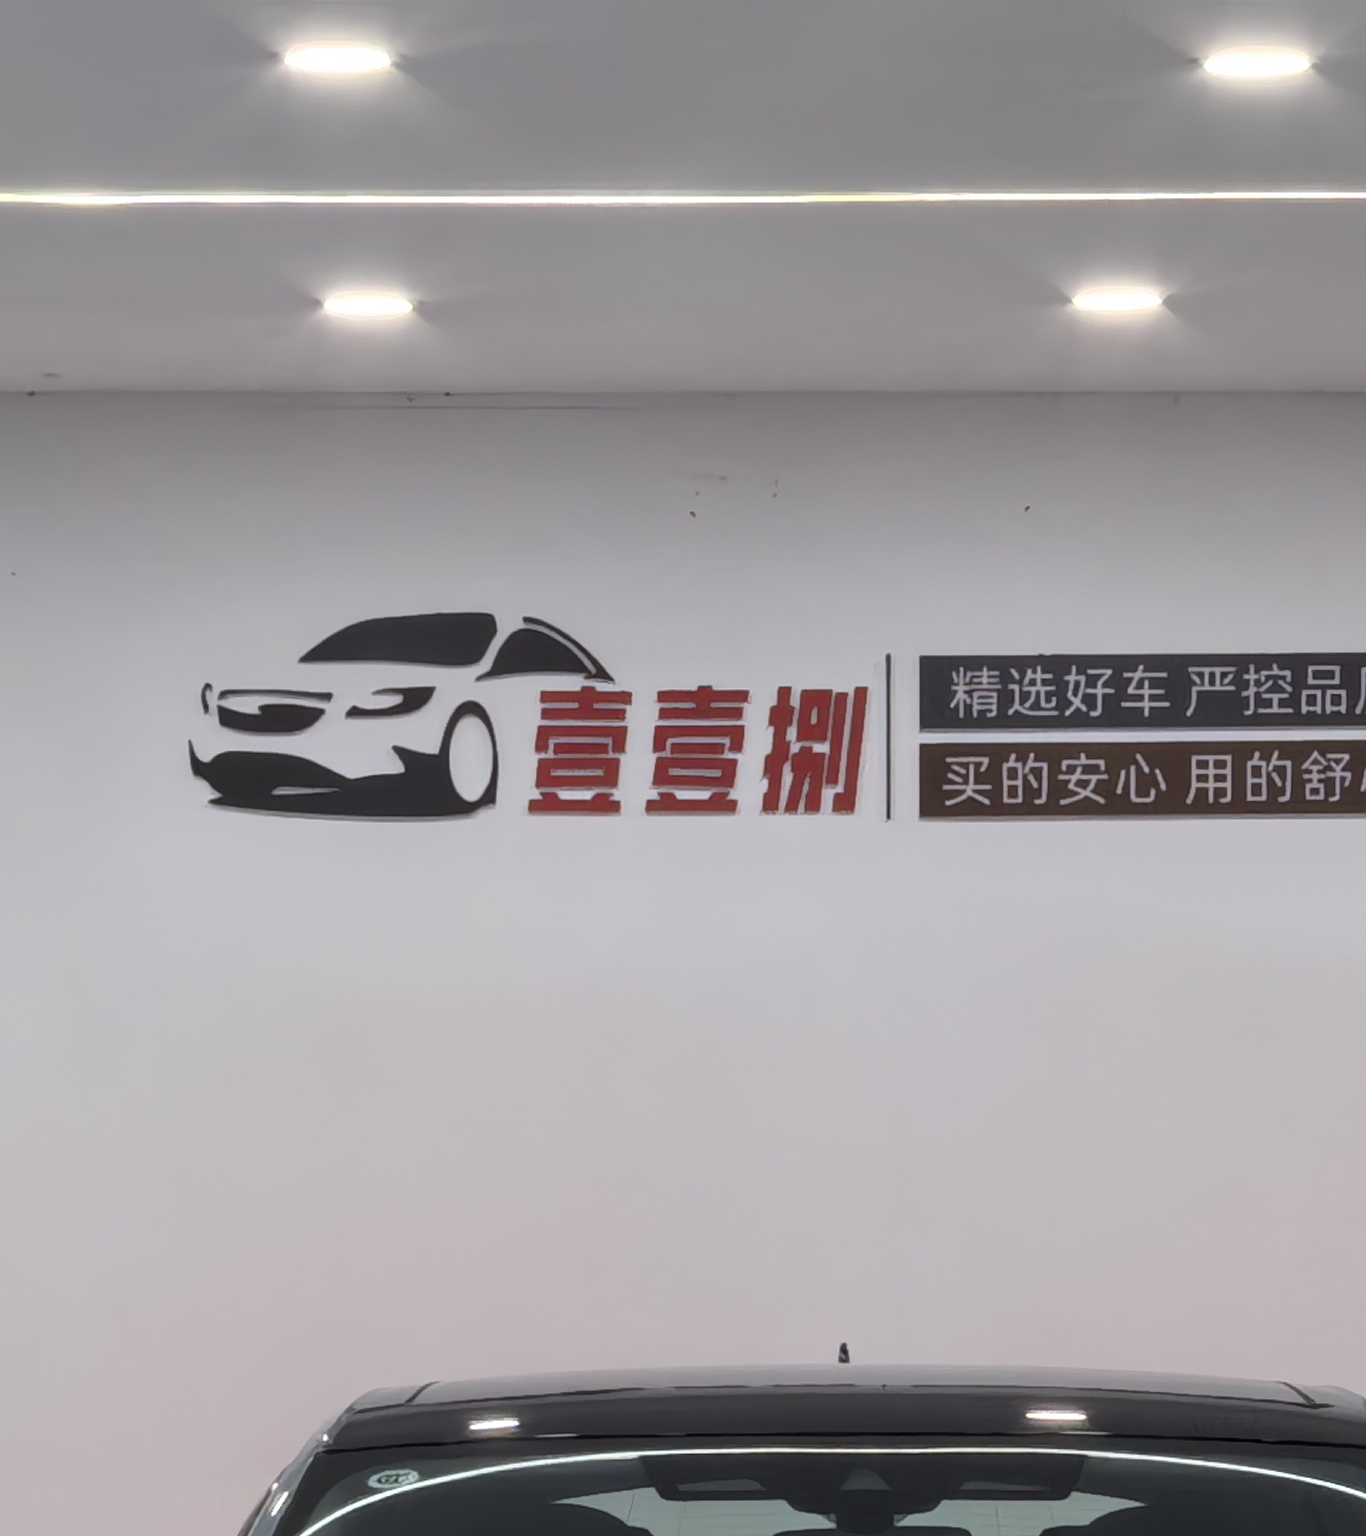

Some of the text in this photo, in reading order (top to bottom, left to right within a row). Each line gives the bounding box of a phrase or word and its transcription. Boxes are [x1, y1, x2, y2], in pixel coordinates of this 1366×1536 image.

[949, 664, 1172, 719] 精选好车
[528, 685, 869, 815] 壹壹捌
[942, 752, 1168, 806] 买的安心
